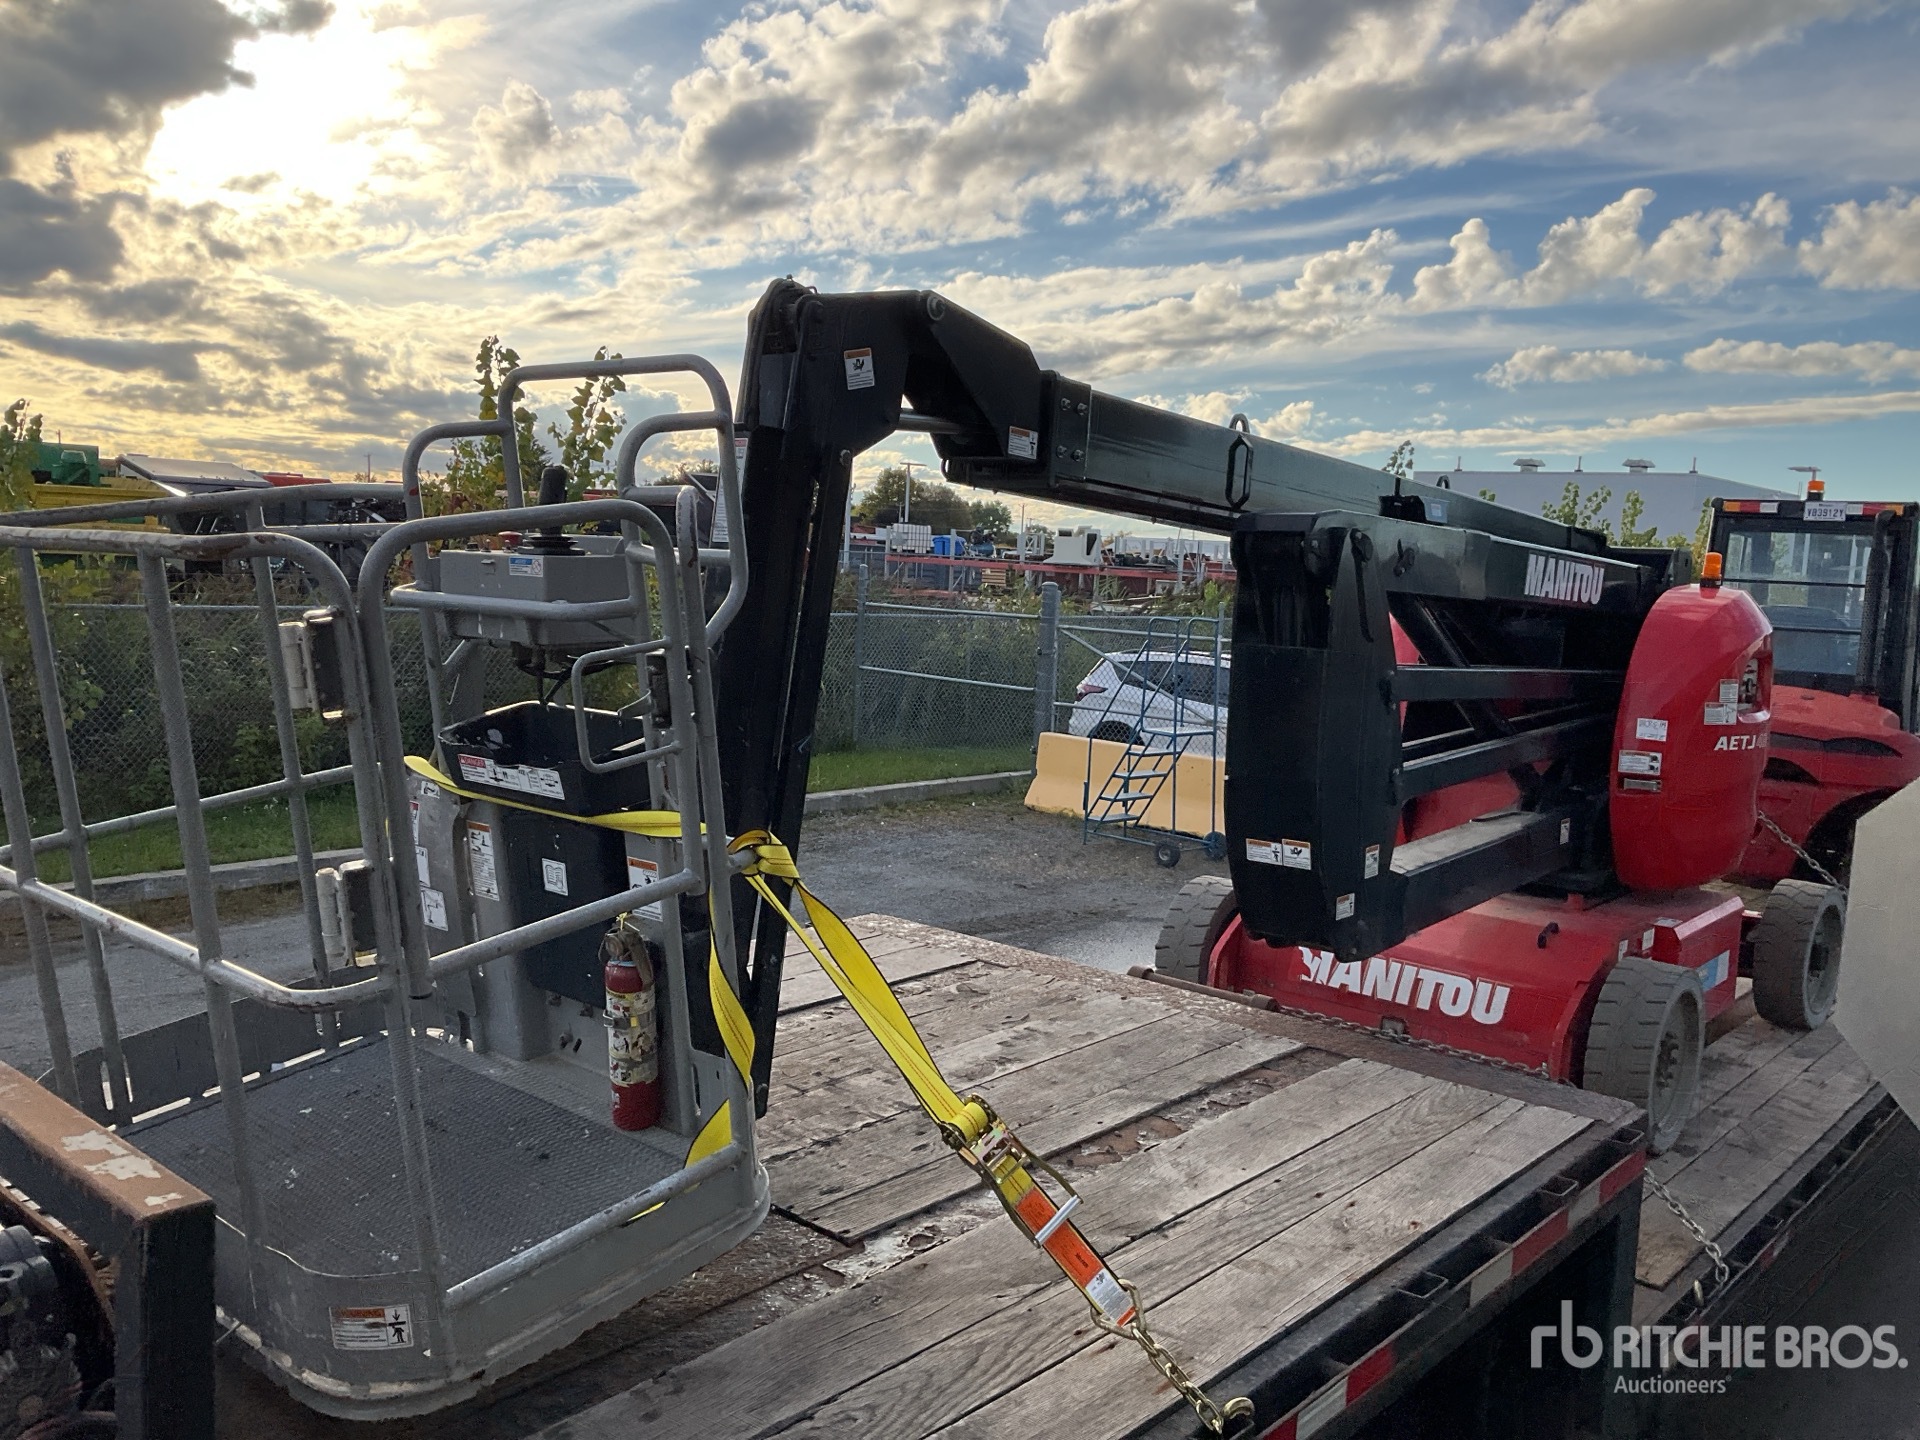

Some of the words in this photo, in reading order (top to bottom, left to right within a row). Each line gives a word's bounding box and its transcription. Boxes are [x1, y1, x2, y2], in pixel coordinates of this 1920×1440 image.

[1524, 553, 1605, 605] MANITOU
[1714, 734, 1757, 751] AETJ
[1299, 946, 1511, 1025] MANITOU
